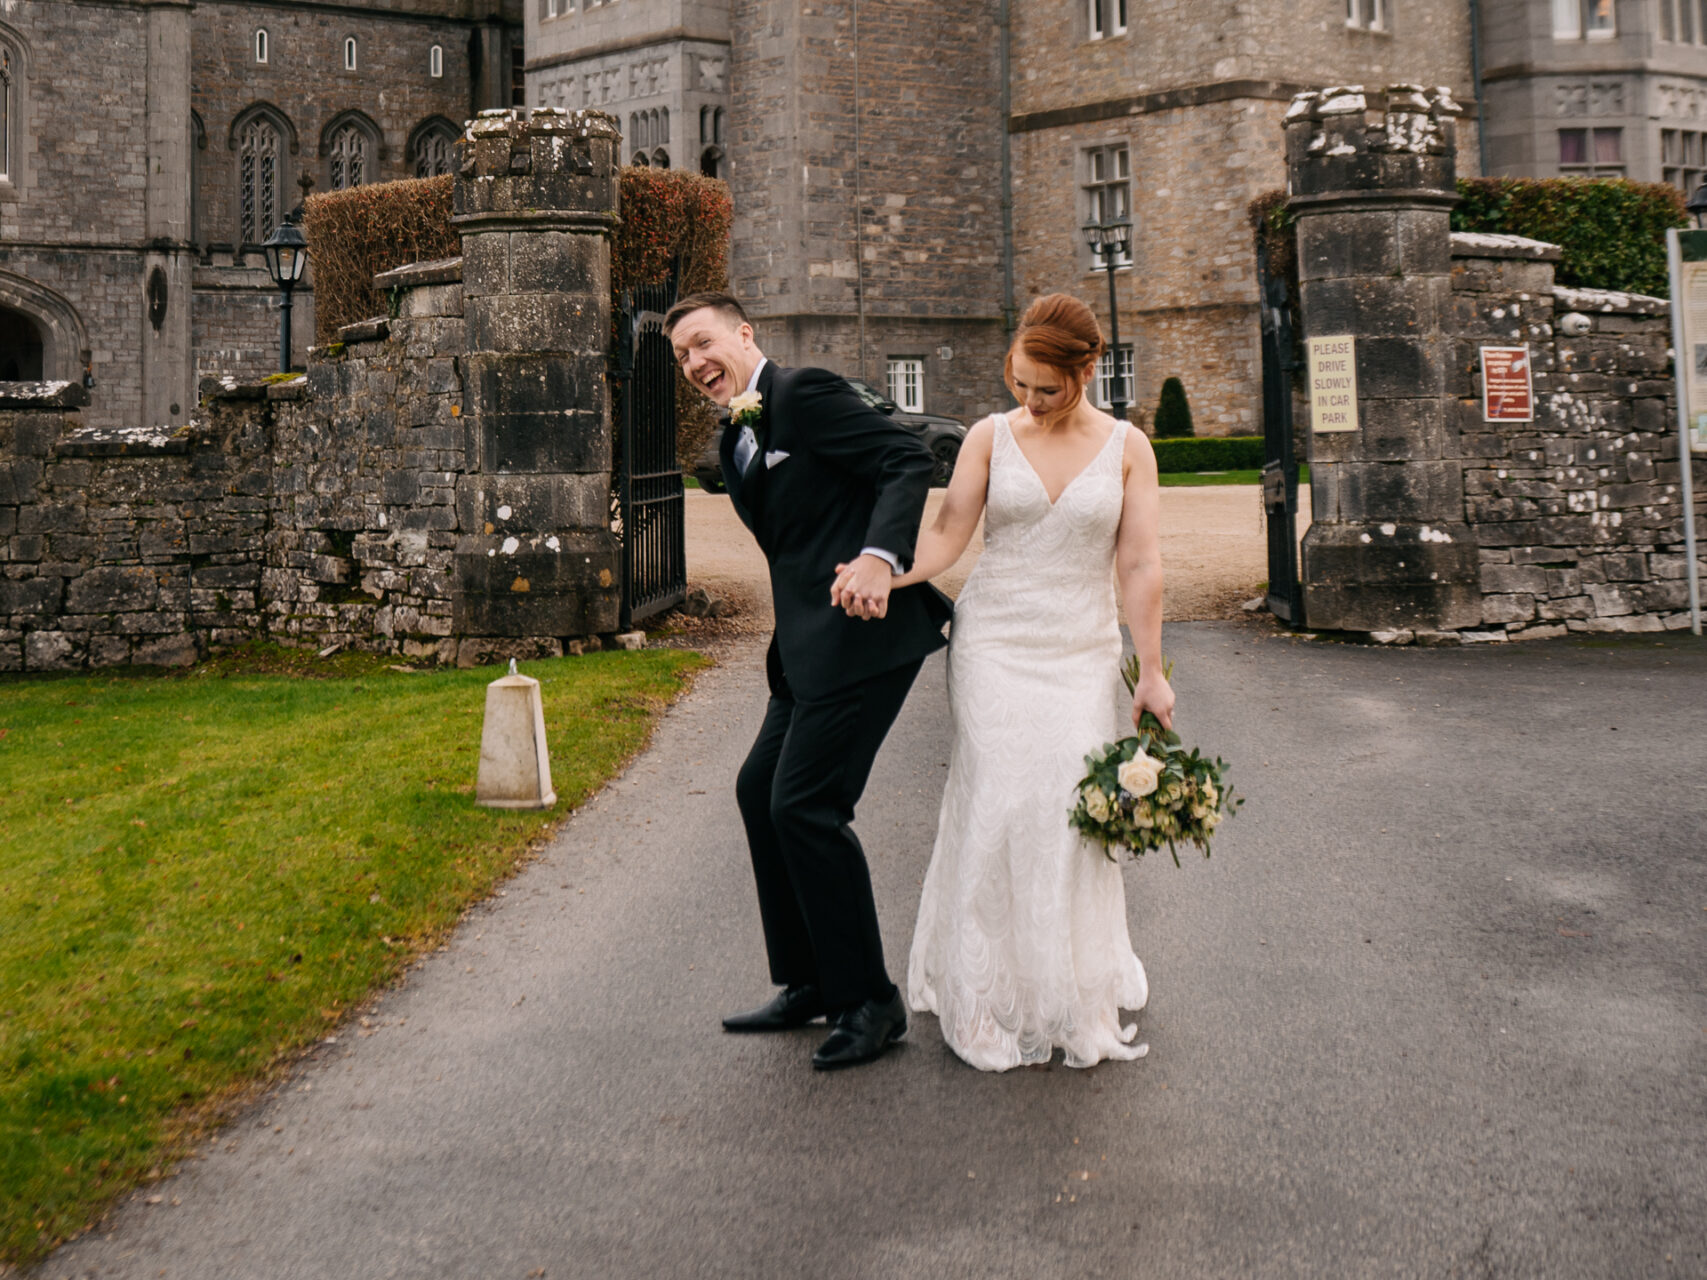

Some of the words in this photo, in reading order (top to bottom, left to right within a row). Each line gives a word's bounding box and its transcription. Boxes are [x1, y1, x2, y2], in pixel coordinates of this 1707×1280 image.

[1314, 343, 1350, 355] PLEASE
[1318, 360, 1347, 372] DRIVE
[1315, 377, 1352, 390] SLOWLY
[1318, 395, 1328, 407] IN
[1330, 394, 1350, 406] CAR
[1322, 412, 1348, 424] PARK
